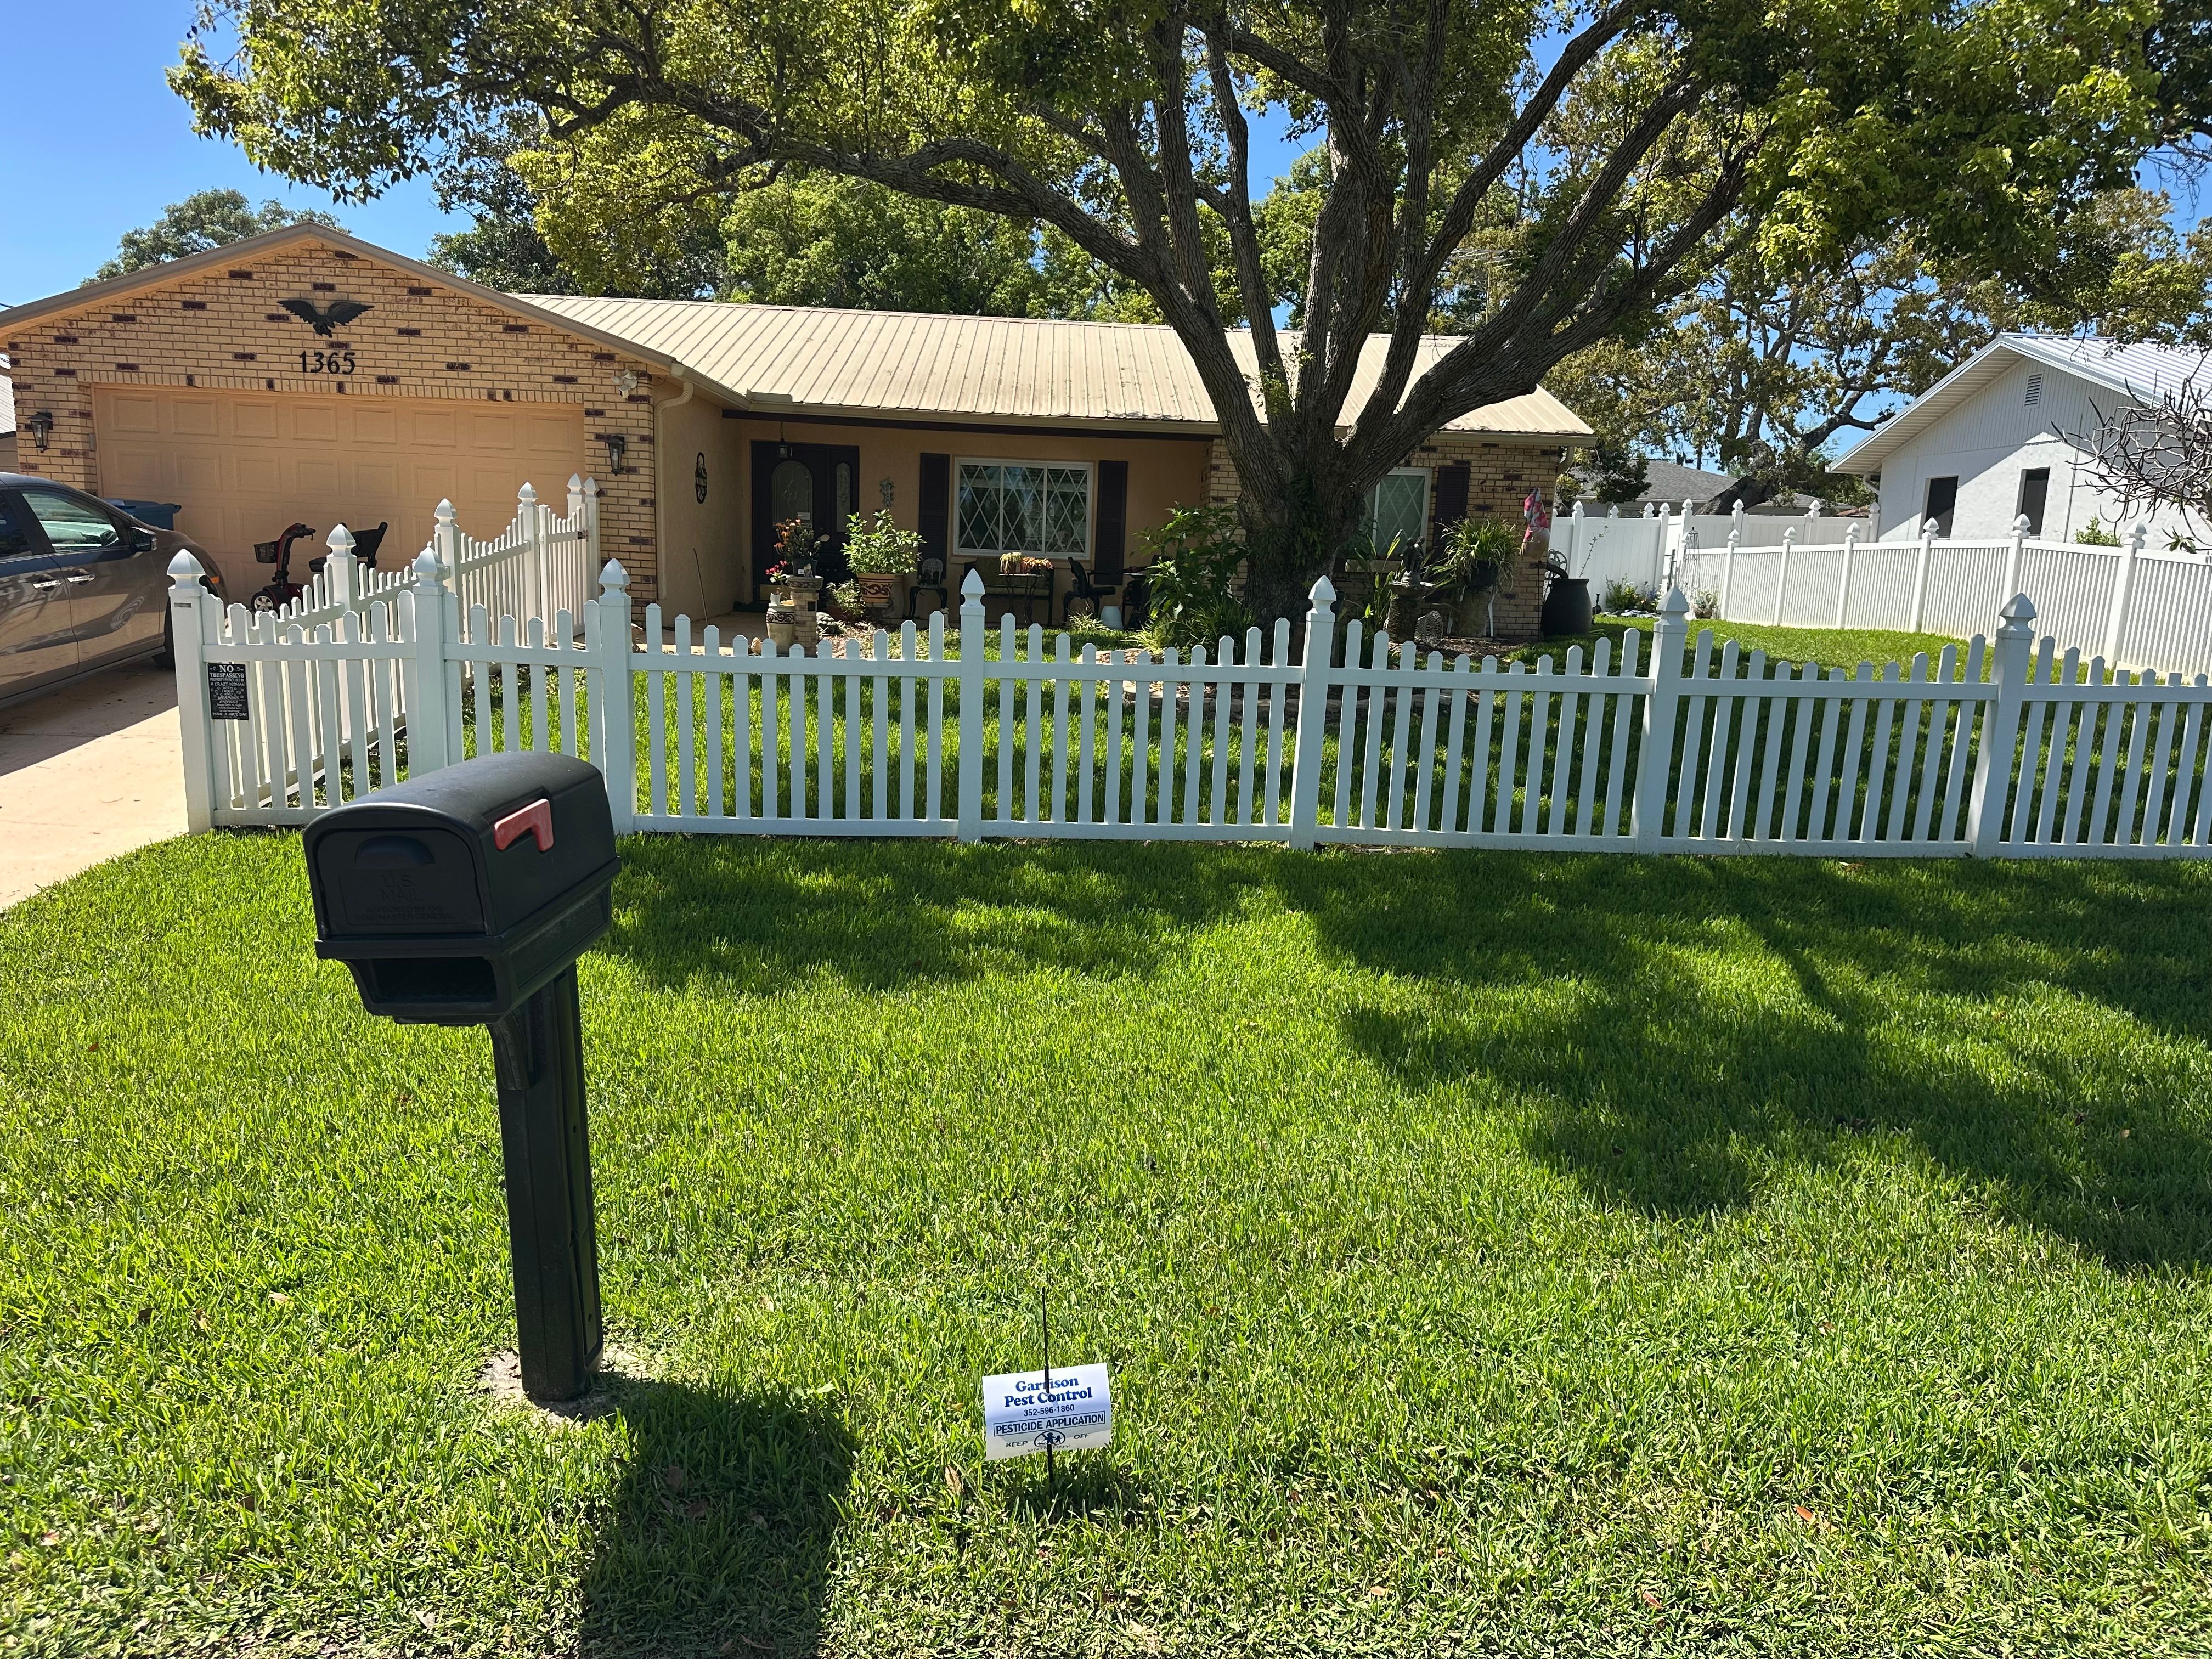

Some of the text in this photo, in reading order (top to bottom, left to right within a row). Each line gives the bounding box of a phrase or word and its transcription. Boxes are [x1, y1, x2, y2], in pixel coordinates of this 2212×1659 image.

[300, 350, 356, 375] 1365
[380, 888, 424, 902] MAIL
[356, 913, 413, 922] POSTMASTER
[1004, 1387, 1093, 1407] Pest Control
[1023, 1404, 1075, 1417] 352-596-1860
[996, 1413, 1104, 1435] PESTICIDE APPLICATION
